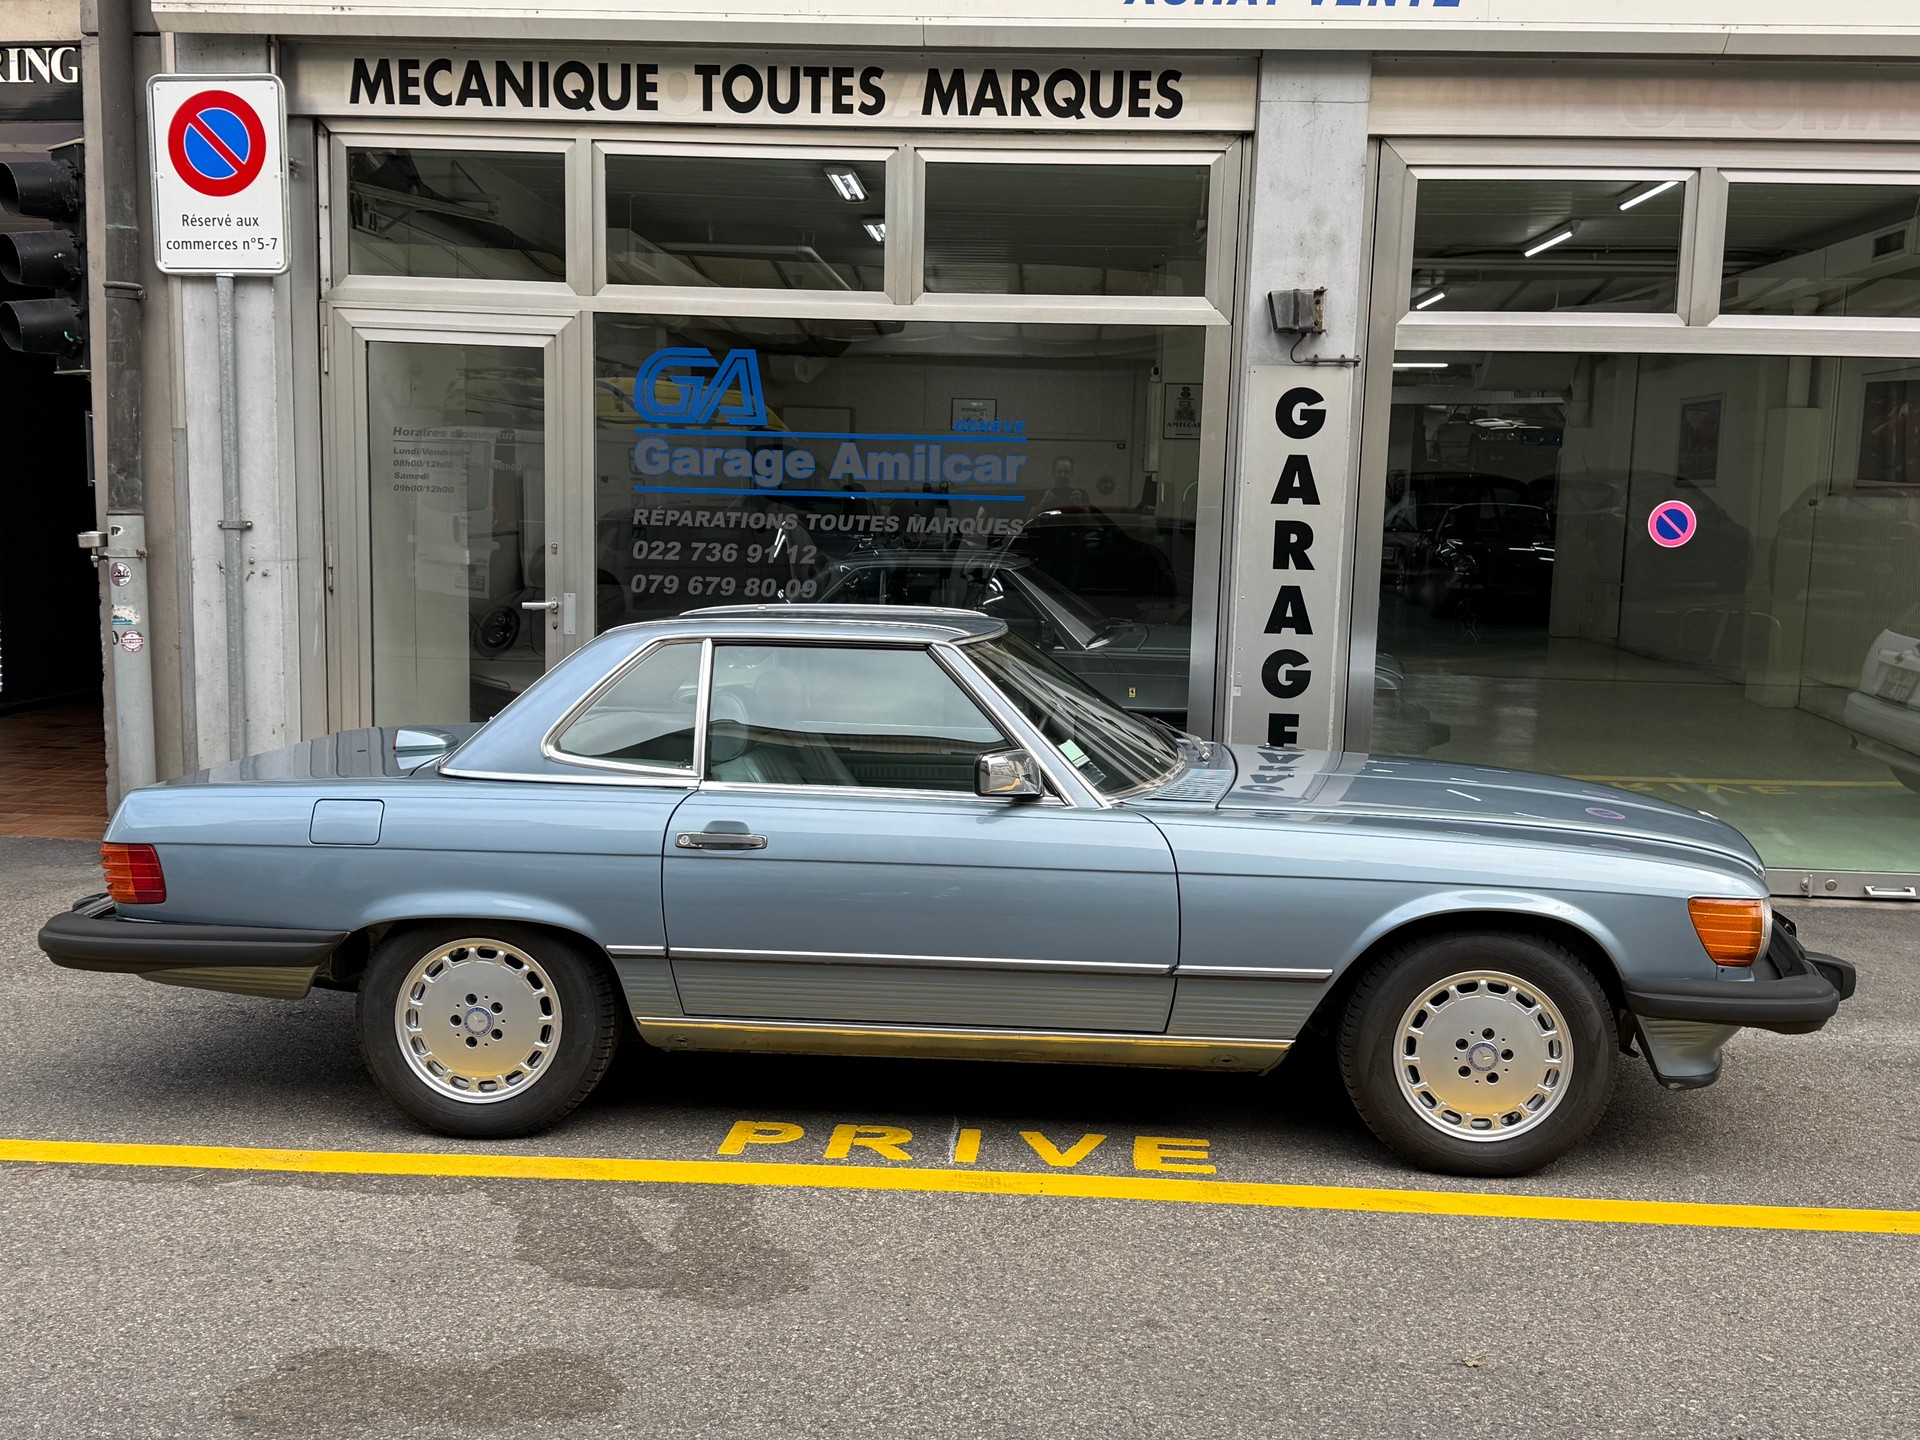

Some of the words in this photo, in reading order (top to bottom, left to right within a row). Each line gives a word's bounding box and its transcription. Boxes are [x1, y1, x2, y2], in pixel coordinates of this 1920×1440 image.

[350, 58, 658, 112] MECANIQUE
[694, 63, 885, 116] TOUTES
[921, 67, 1183, 121] MARQUES
[181, 213, 232, 227] Réservé
[237, 217, 259, 227] aux
[166, 240, 238, 250] commerces
[242, 237, 277, 251] n°5-7
[633, 347, 769, 427] GA
[392, 426, 448, 438] Horaires
[393, 471, 430, 480] Samedi
[633, 437, 817, 488] Garage
[828, 441, 1028, 484] Amilcar
[633, 506, 798, 530] RÉPARATIONS
[806, 514, 899, 533] TOUTES
[906, 516, 1024, 537] MARQUES
[632, 541, 682, 560] 022
[691, 542, 739, 562] 736
[746, 544, 777, 564] 91
[786, 545, 818, 564] 12
[1261, 387, 1327, 747] GARAGE
[630, 574, 680, 594] 079
[687, 576, 737, 596] 679
[743, 578, 777, 598] 80
[785, 579, 818, 599] 09
[716, 1120, 1217, 1174] PRIVE
